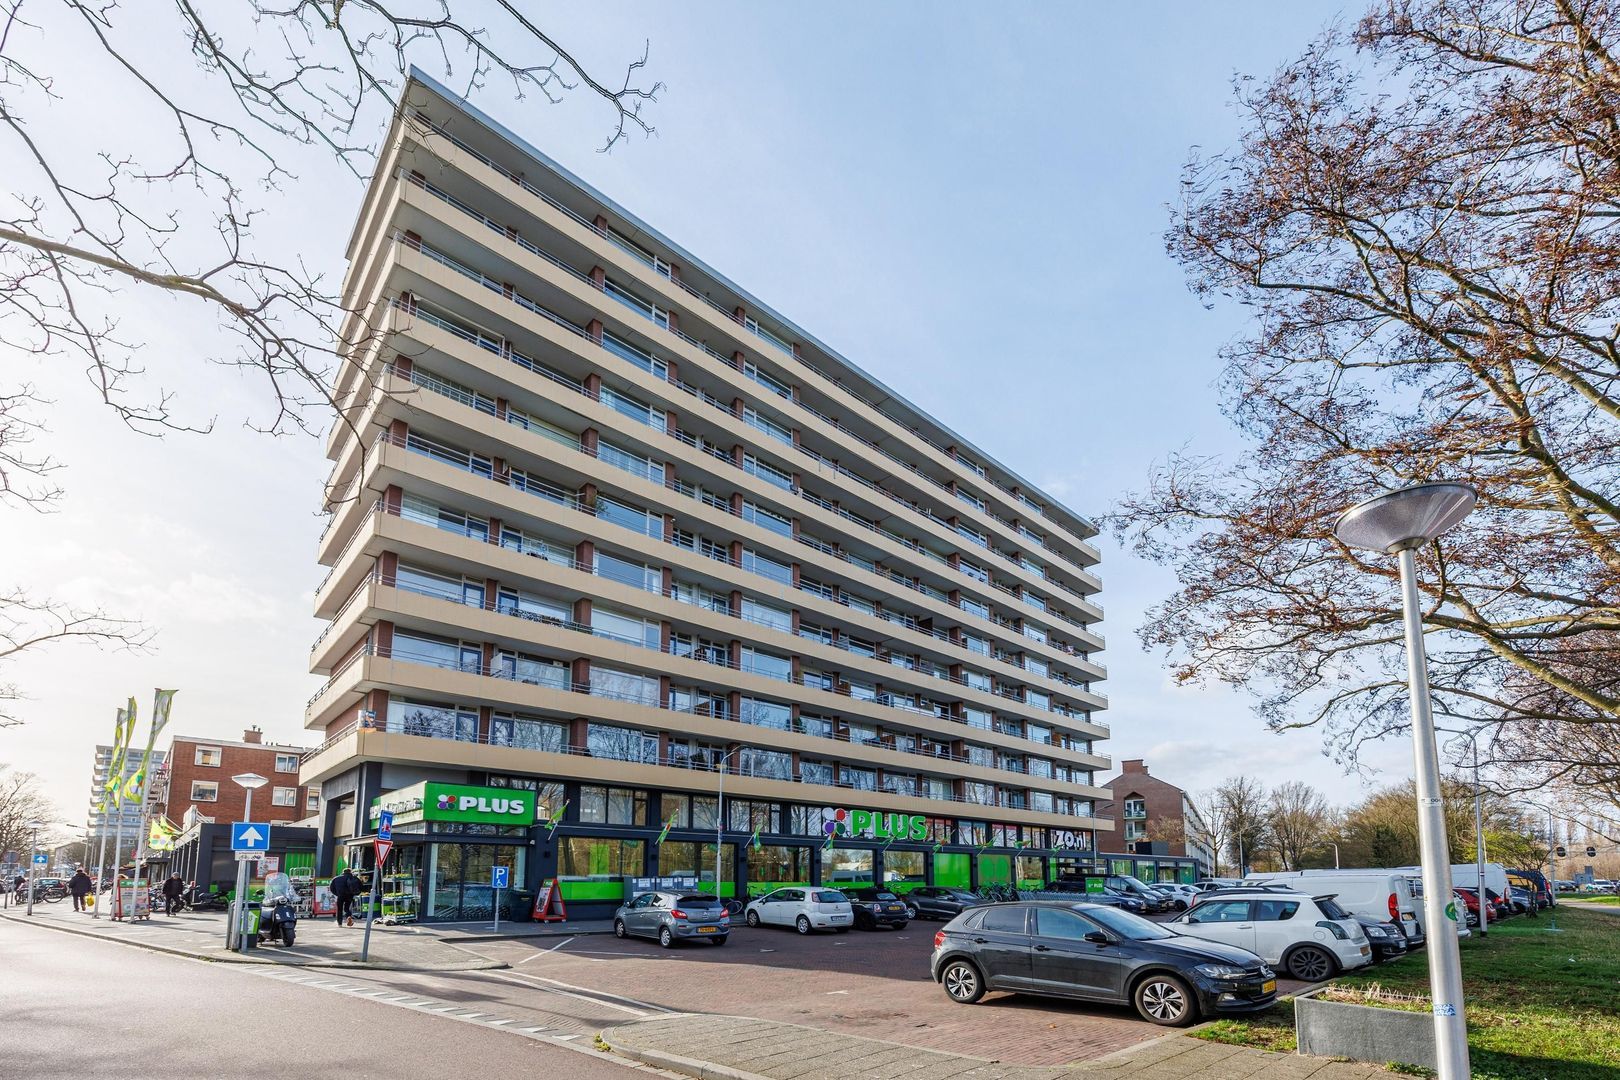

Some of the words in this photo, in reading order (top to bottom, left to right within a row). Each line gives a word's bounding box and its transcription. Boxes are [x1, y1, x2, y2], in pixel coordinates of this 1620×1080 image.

[459, 796, 525, 815] PLUS
[849, 809, 928, 841] PLUS
[496, 868, 505, 879] P
